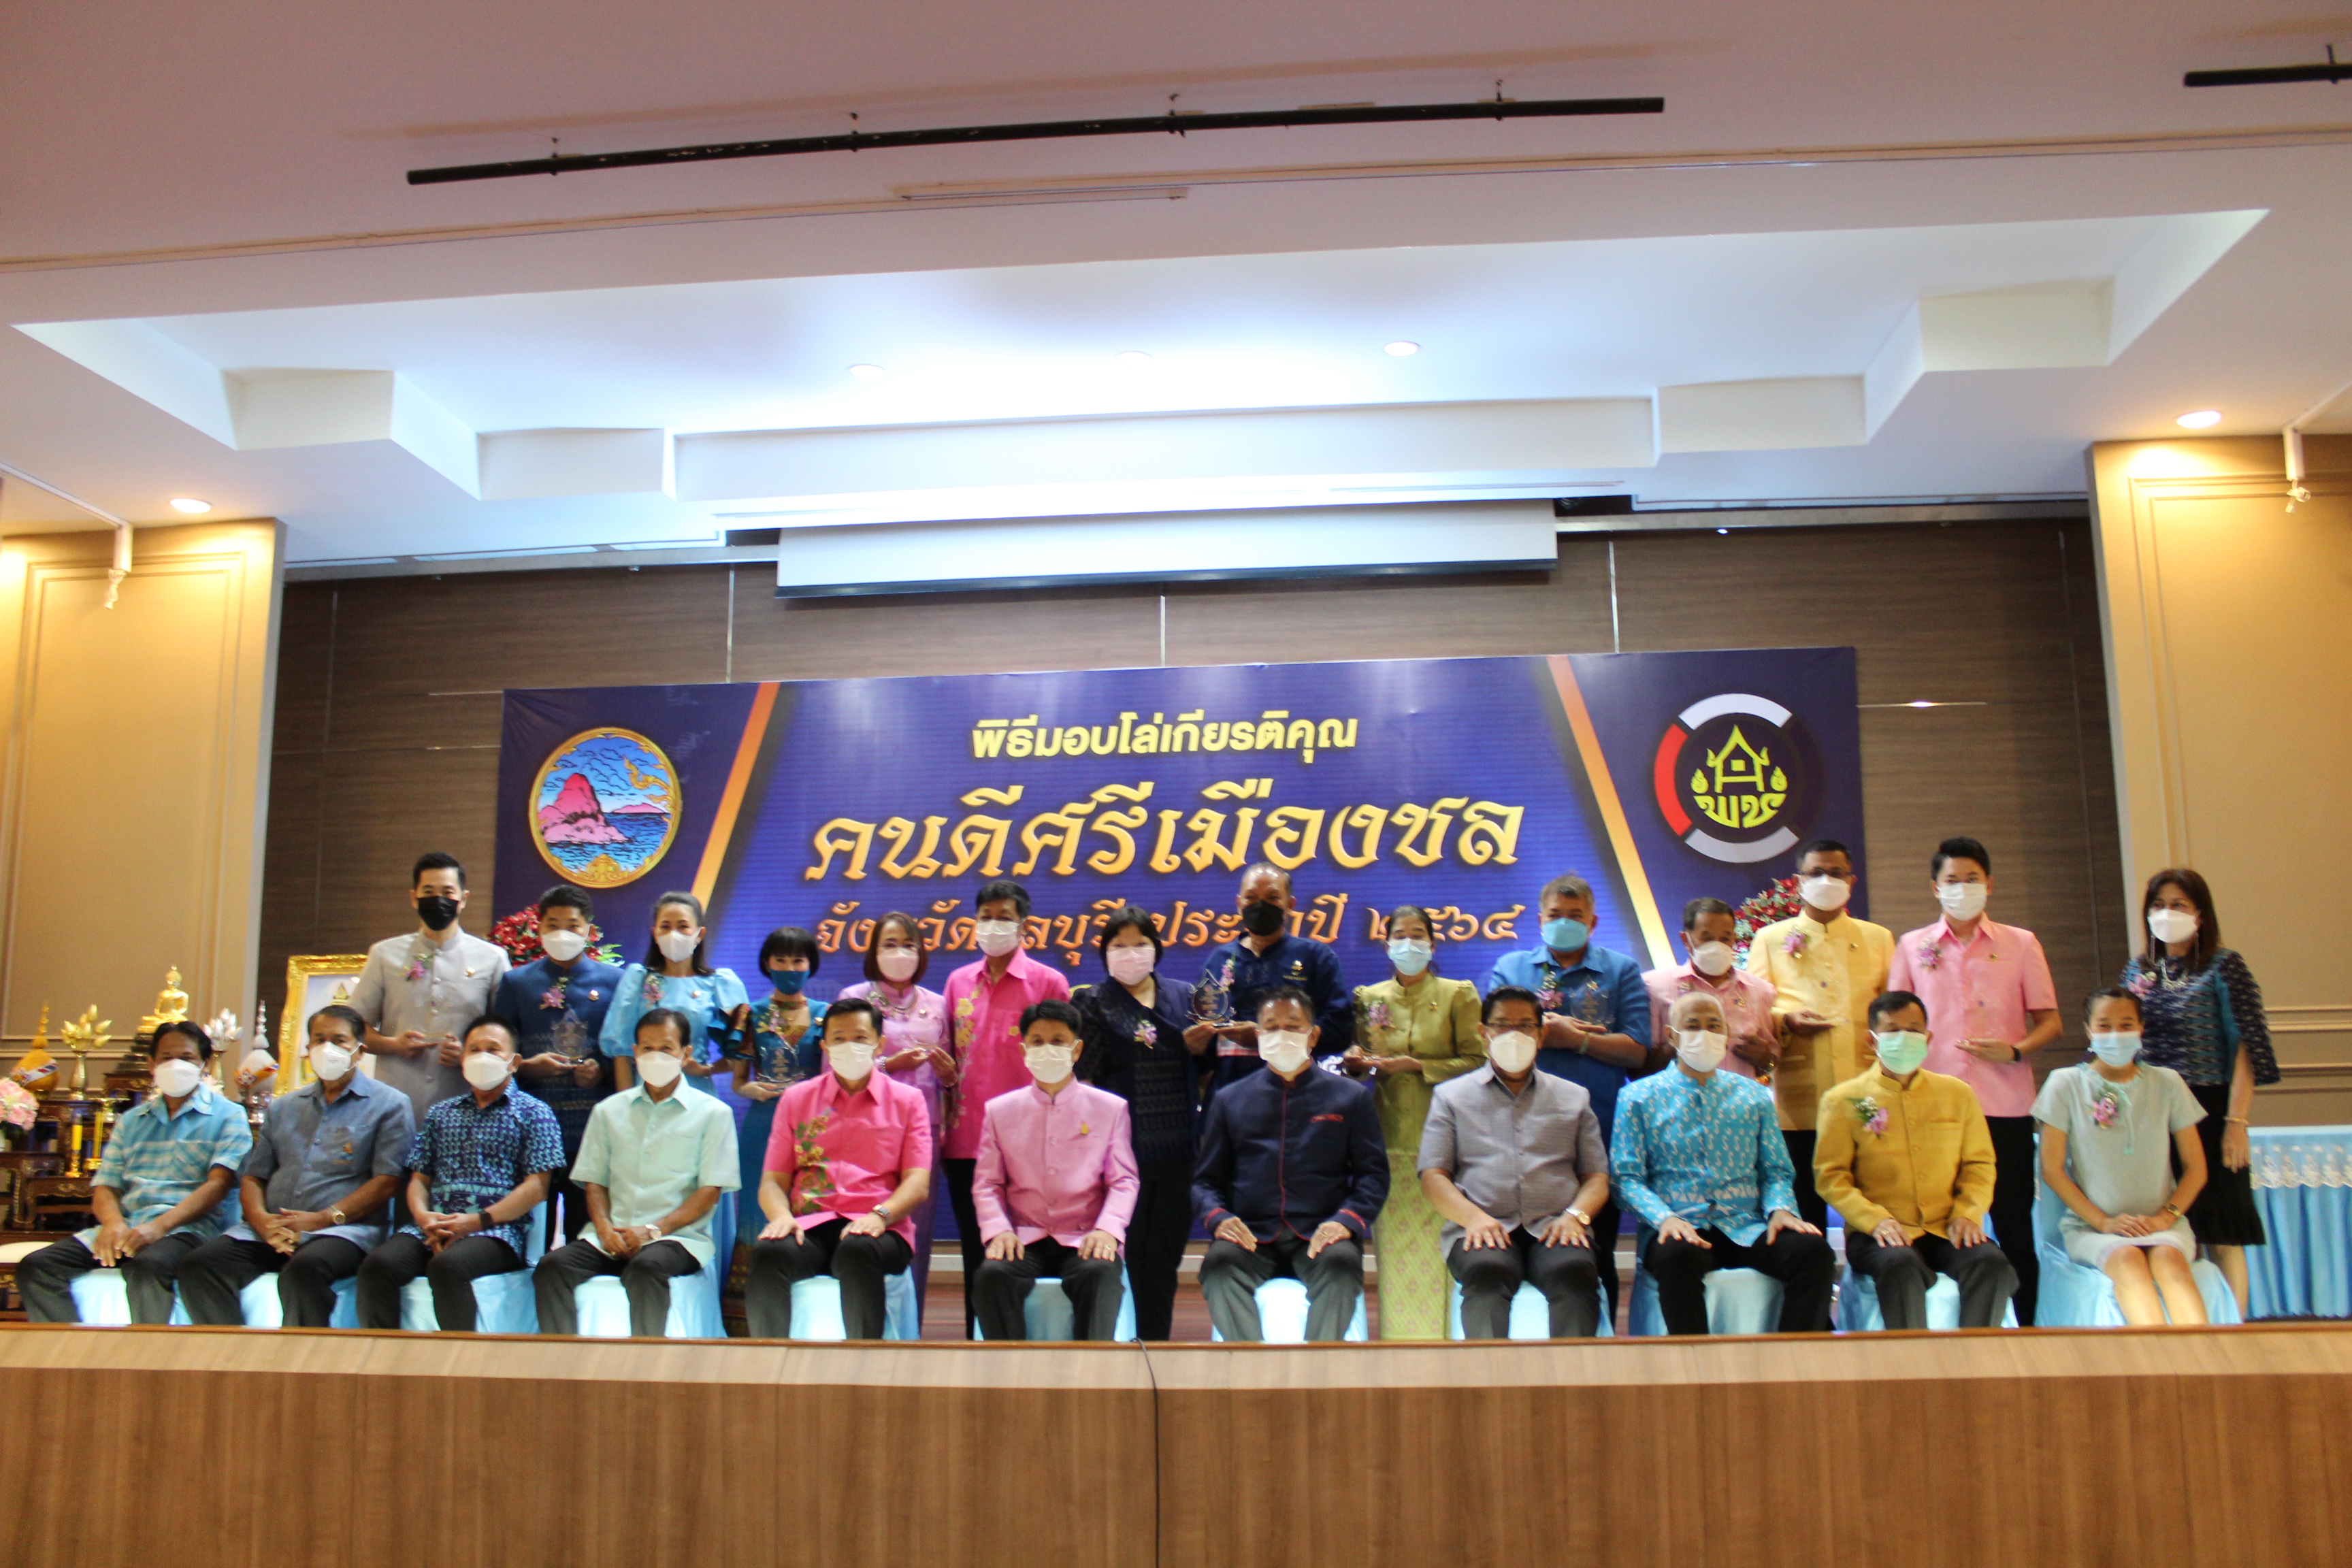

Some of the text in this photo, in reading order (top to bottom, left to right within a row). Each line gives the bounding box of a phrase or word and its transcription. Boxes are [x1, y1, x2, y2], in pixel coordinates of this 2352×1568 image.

[971, 708, 1358, 764] พิธีมอบโล่เกียรติคุณ
[804, 777, 1525, 881] คนดีศรีเมืองชล
[816, 898, 1126, 966] จังวัดลบุี
[1148, 892, 1348, 947] ประปี
